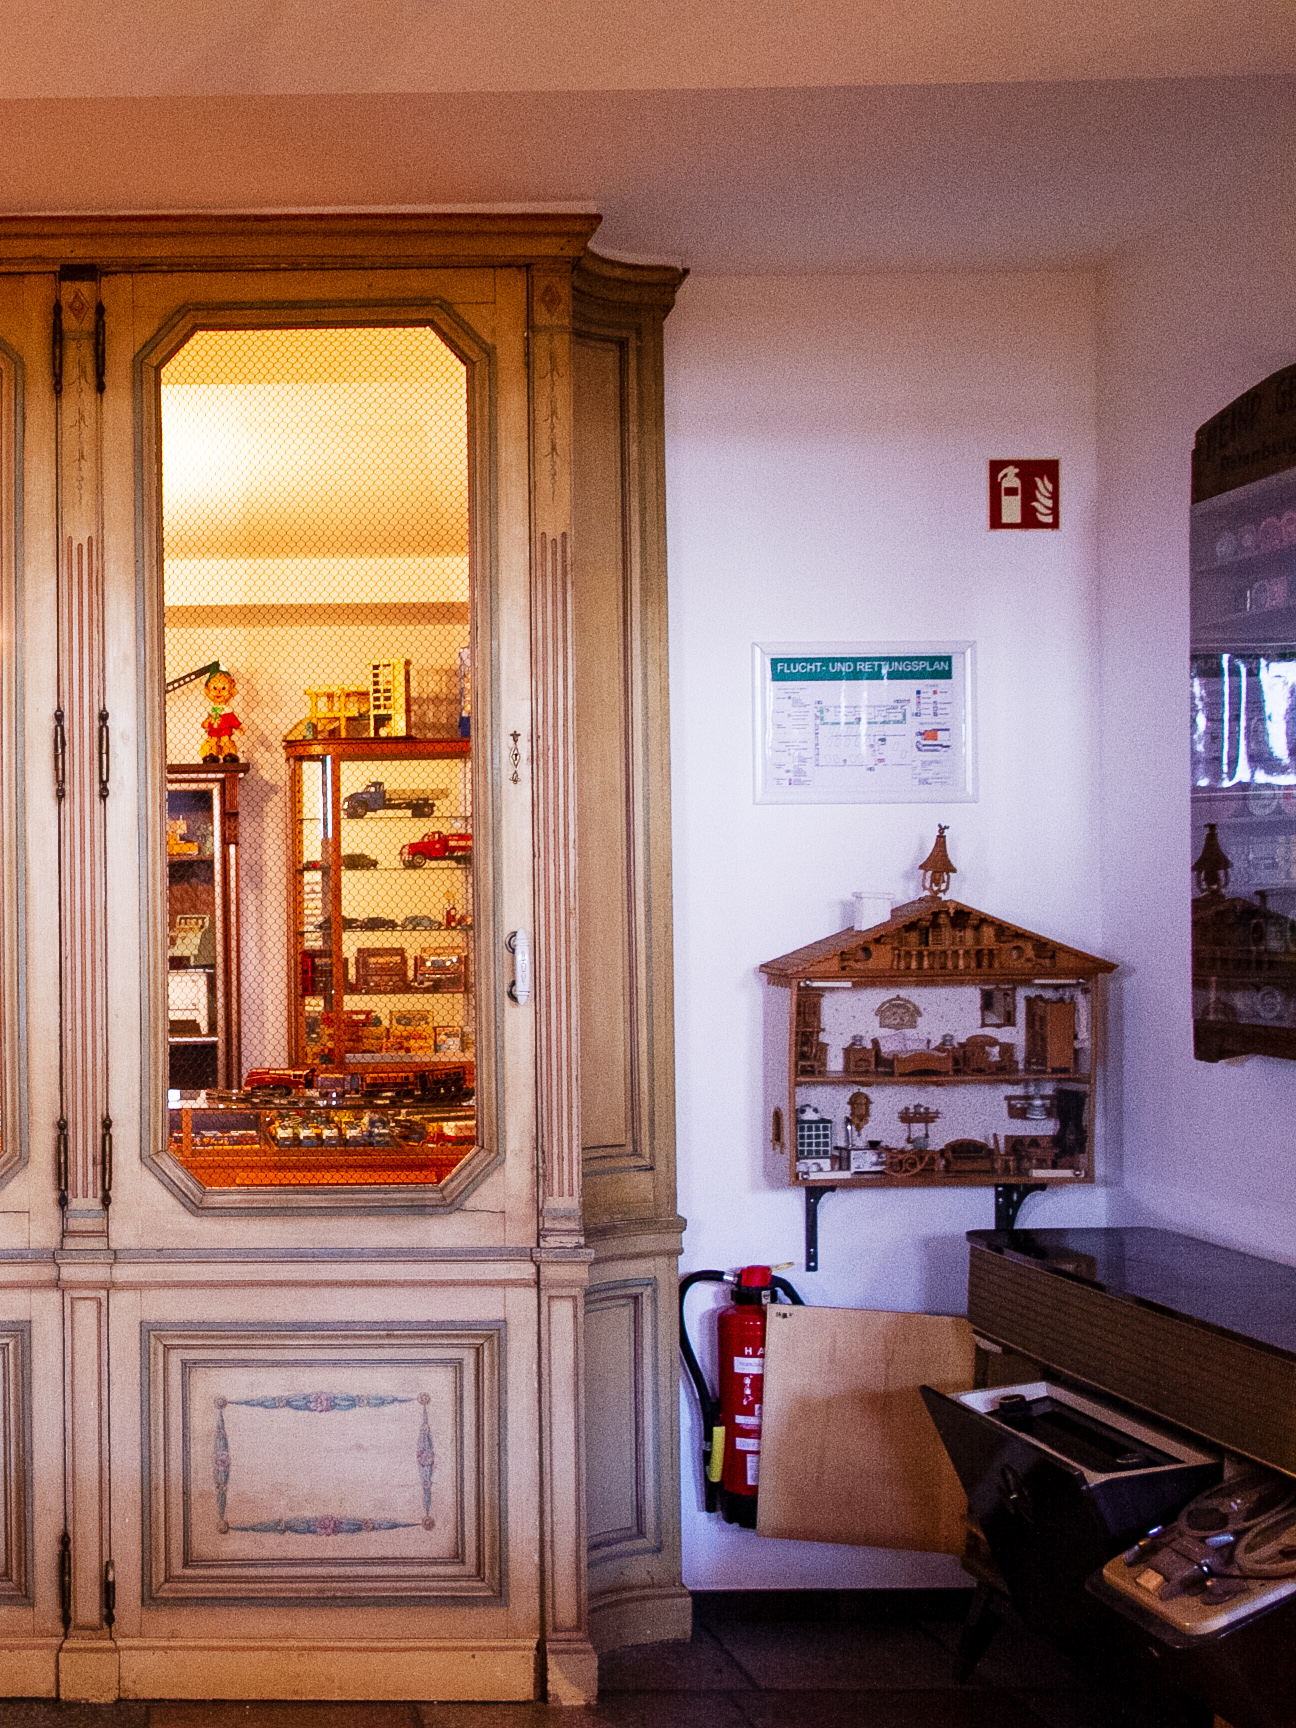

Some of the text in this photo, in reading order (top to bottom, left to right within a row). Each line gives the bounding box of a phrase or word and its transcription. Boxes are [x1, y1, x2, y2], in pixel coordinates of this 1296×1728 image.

[776, 660, 950, 674] FLUCHT- UND RETTUNGSPLAN
